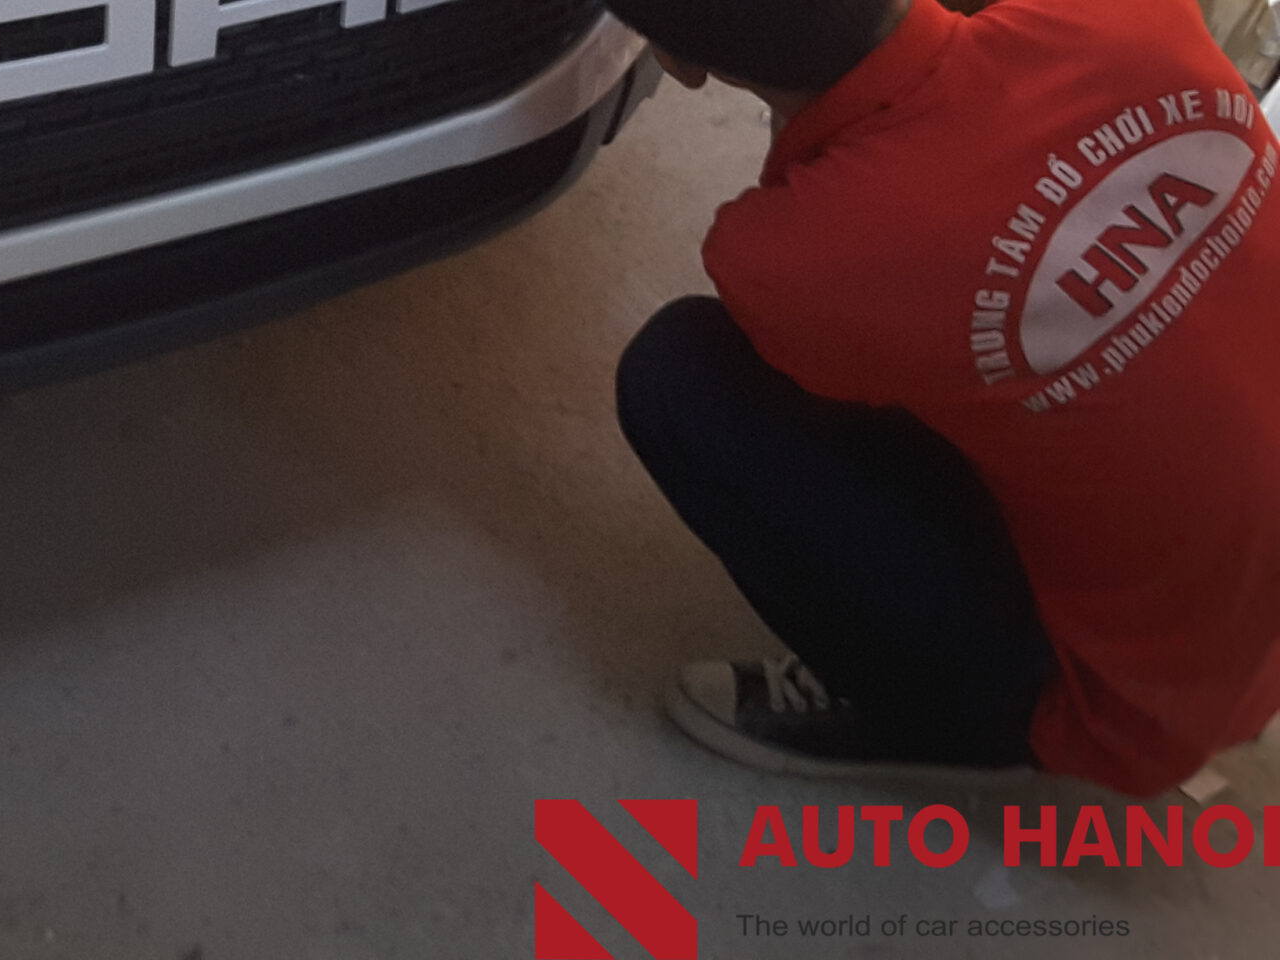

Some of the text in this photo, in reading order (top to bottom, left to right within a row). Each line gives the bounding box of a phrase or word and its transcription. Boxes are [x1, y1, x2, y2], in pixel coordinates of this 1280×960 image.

[1157, 89, 1205, 126] XE
[986, 203, 1046, 279] TÂM
[1055, 172, 1219, 319] HNA
[970, 289, 1017, 386] TRUNG
